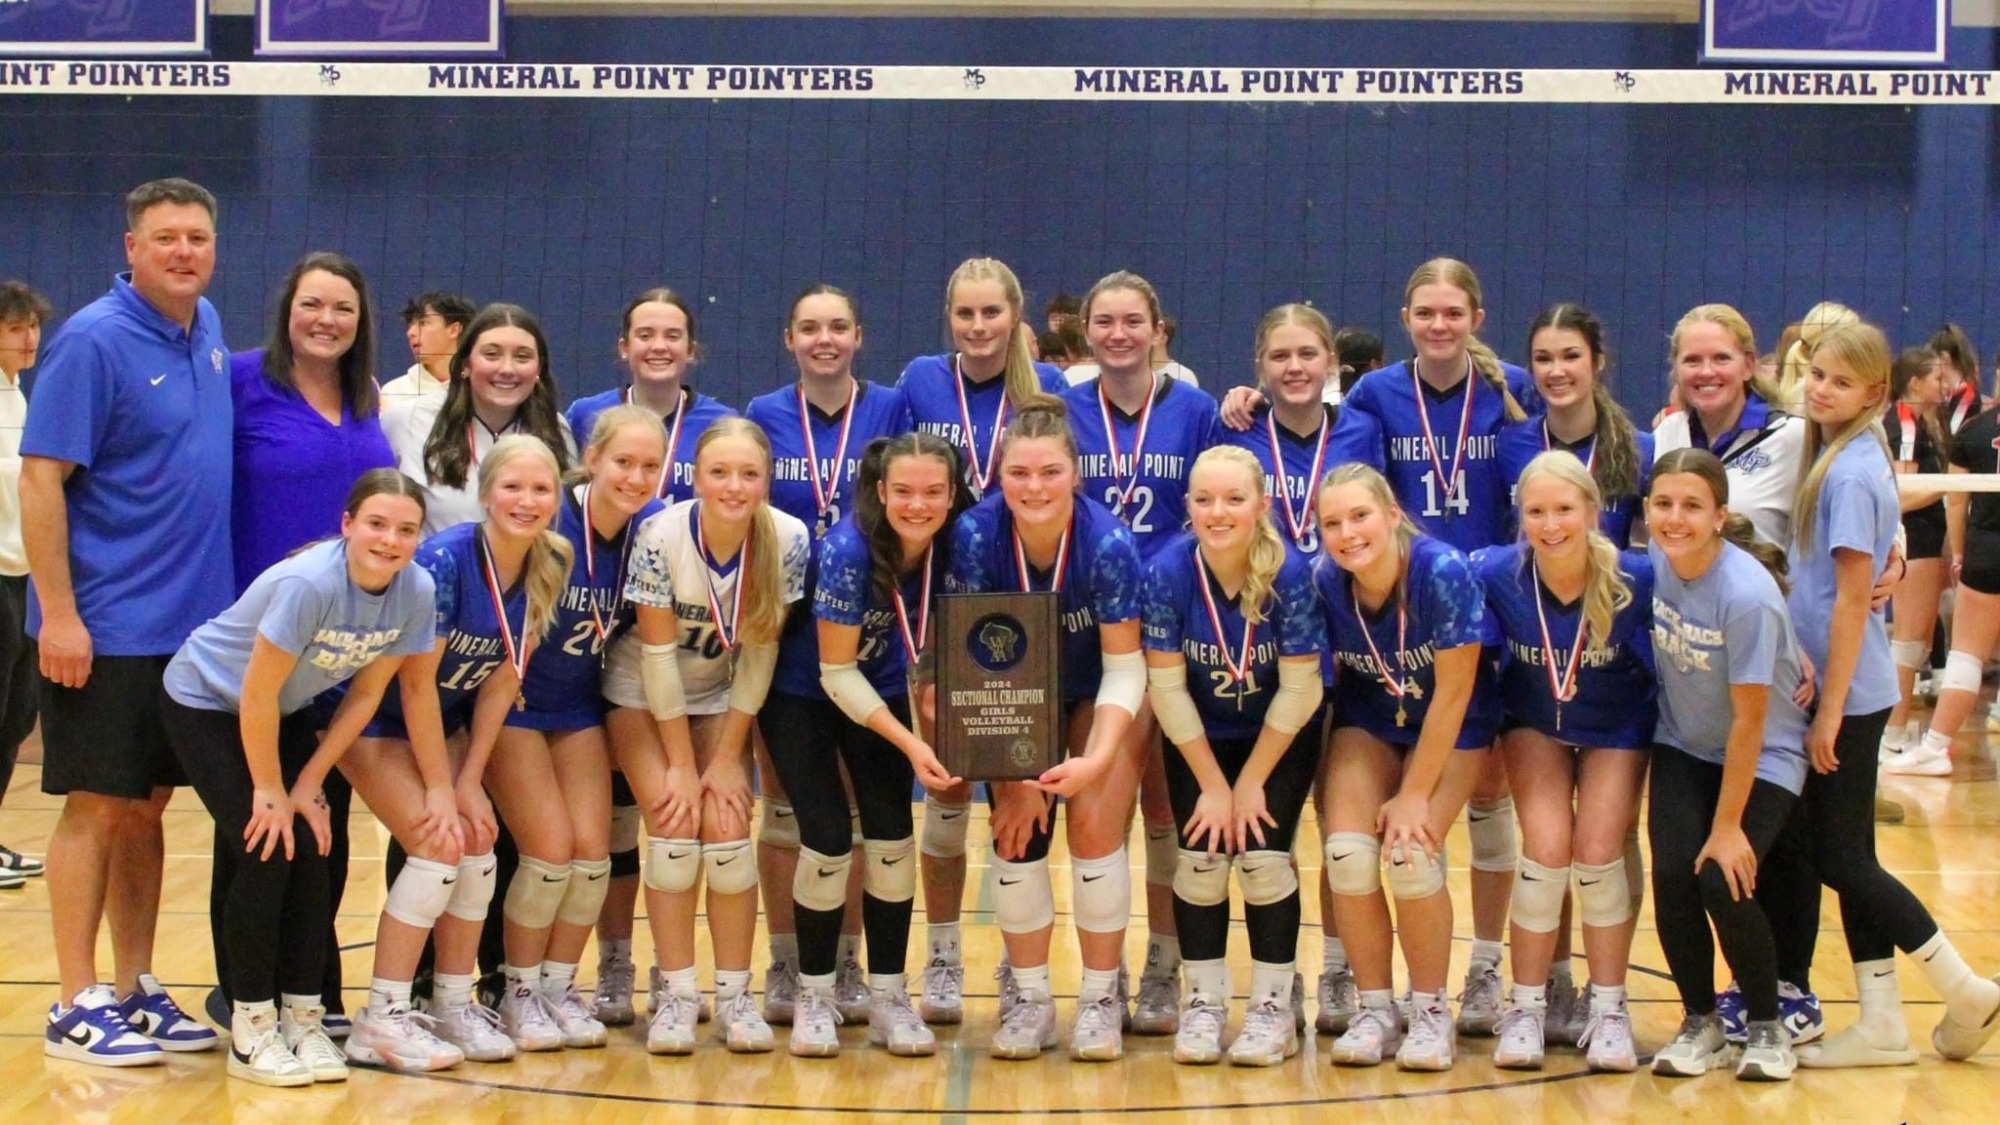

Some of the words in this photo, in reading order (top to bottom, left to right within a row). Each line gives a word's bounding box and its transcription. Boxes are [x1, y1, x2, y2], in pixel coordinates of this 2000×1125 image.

[68, 63, 231, 87] POINTERS
[428, 65, 580, 89] MINERAL
[592, 66, 694, 90] POINT
[706, 67, 873, 91] POINTERS
[1074, 69, 1229, 93] MINERAL
[1241, 70, 1344, 94] POINT
[1356, 70, 1523, 94] POINTERS
[1724, 72, 1878, 95] MINERAL
[1889, 73, 1991, 96] POINT
[1144, 453, 1185, 480] POINT
[1420, 469, 1470, 517] 14
[1104, 484, 1154, 534] 22
[440, 661, 501, 691] 15
[984, 681, 1012, 689] 2024
[1210, 670, 1262, 698] 21
[951, 691, 998, 706] SECTIONAL
[1000, 689, 1044, 705] CHAMPION
[962, 716, 1034, 726] VOLLEYBALL
[981, 707, 1016, 716] GIRLS
[967, 726, 1019, 736] DIVISION
[1022, 726, 1029, 735] 4
